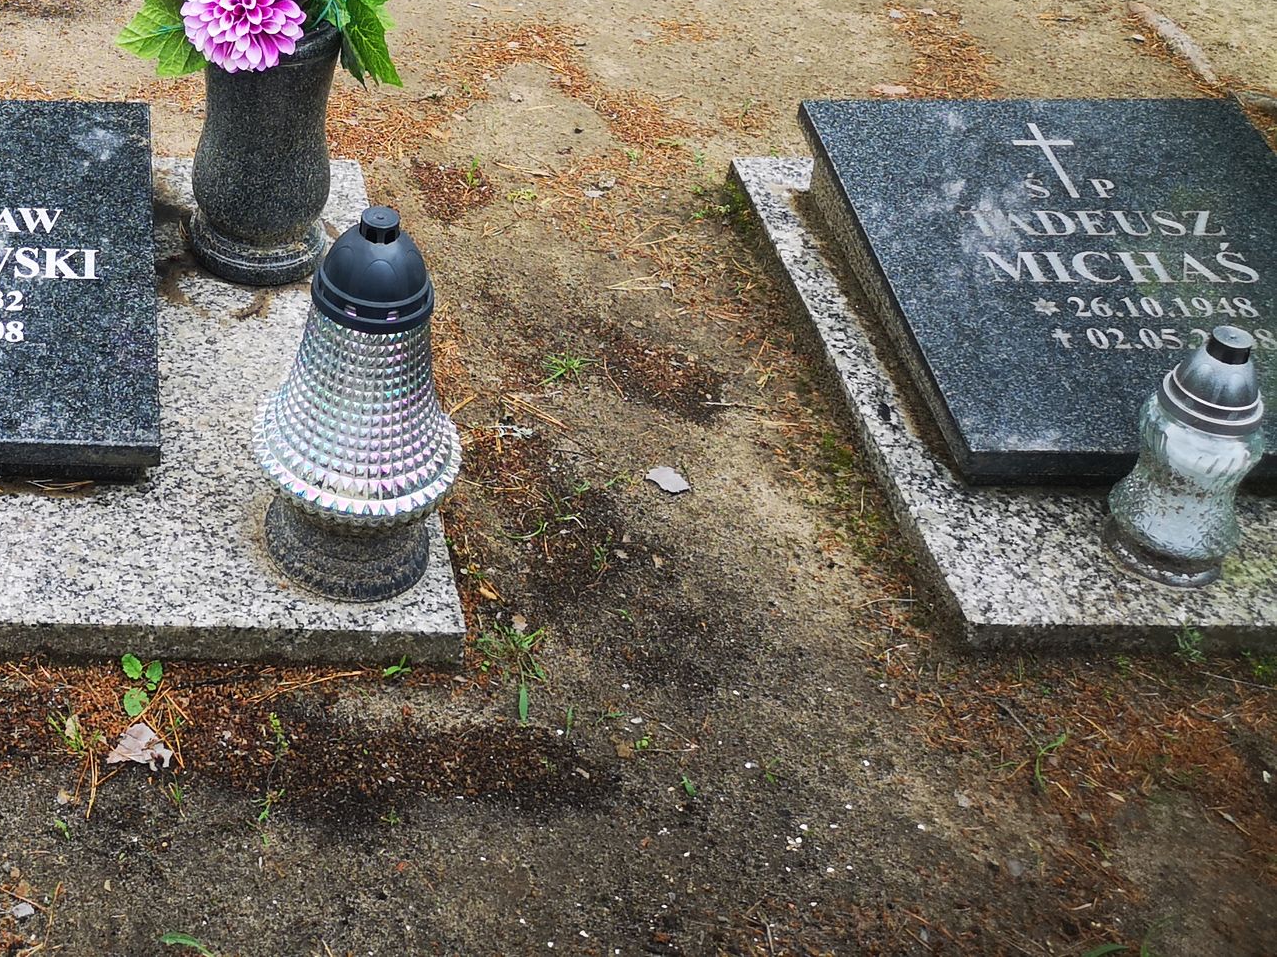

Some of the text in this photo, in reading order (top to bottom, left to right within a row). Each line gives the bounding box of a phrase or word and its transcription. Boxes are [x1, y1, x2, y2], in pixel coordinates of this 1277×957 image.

[1088, 178, 1116, 199] P
[959, 210, 1227, 237] TADEUSZ
[981, 241, 1261, 284] MICHAŚ
[1066, 296, 1261, 319] 26.10.1948
[1085, 327, 1277, 351] 02.05.28
